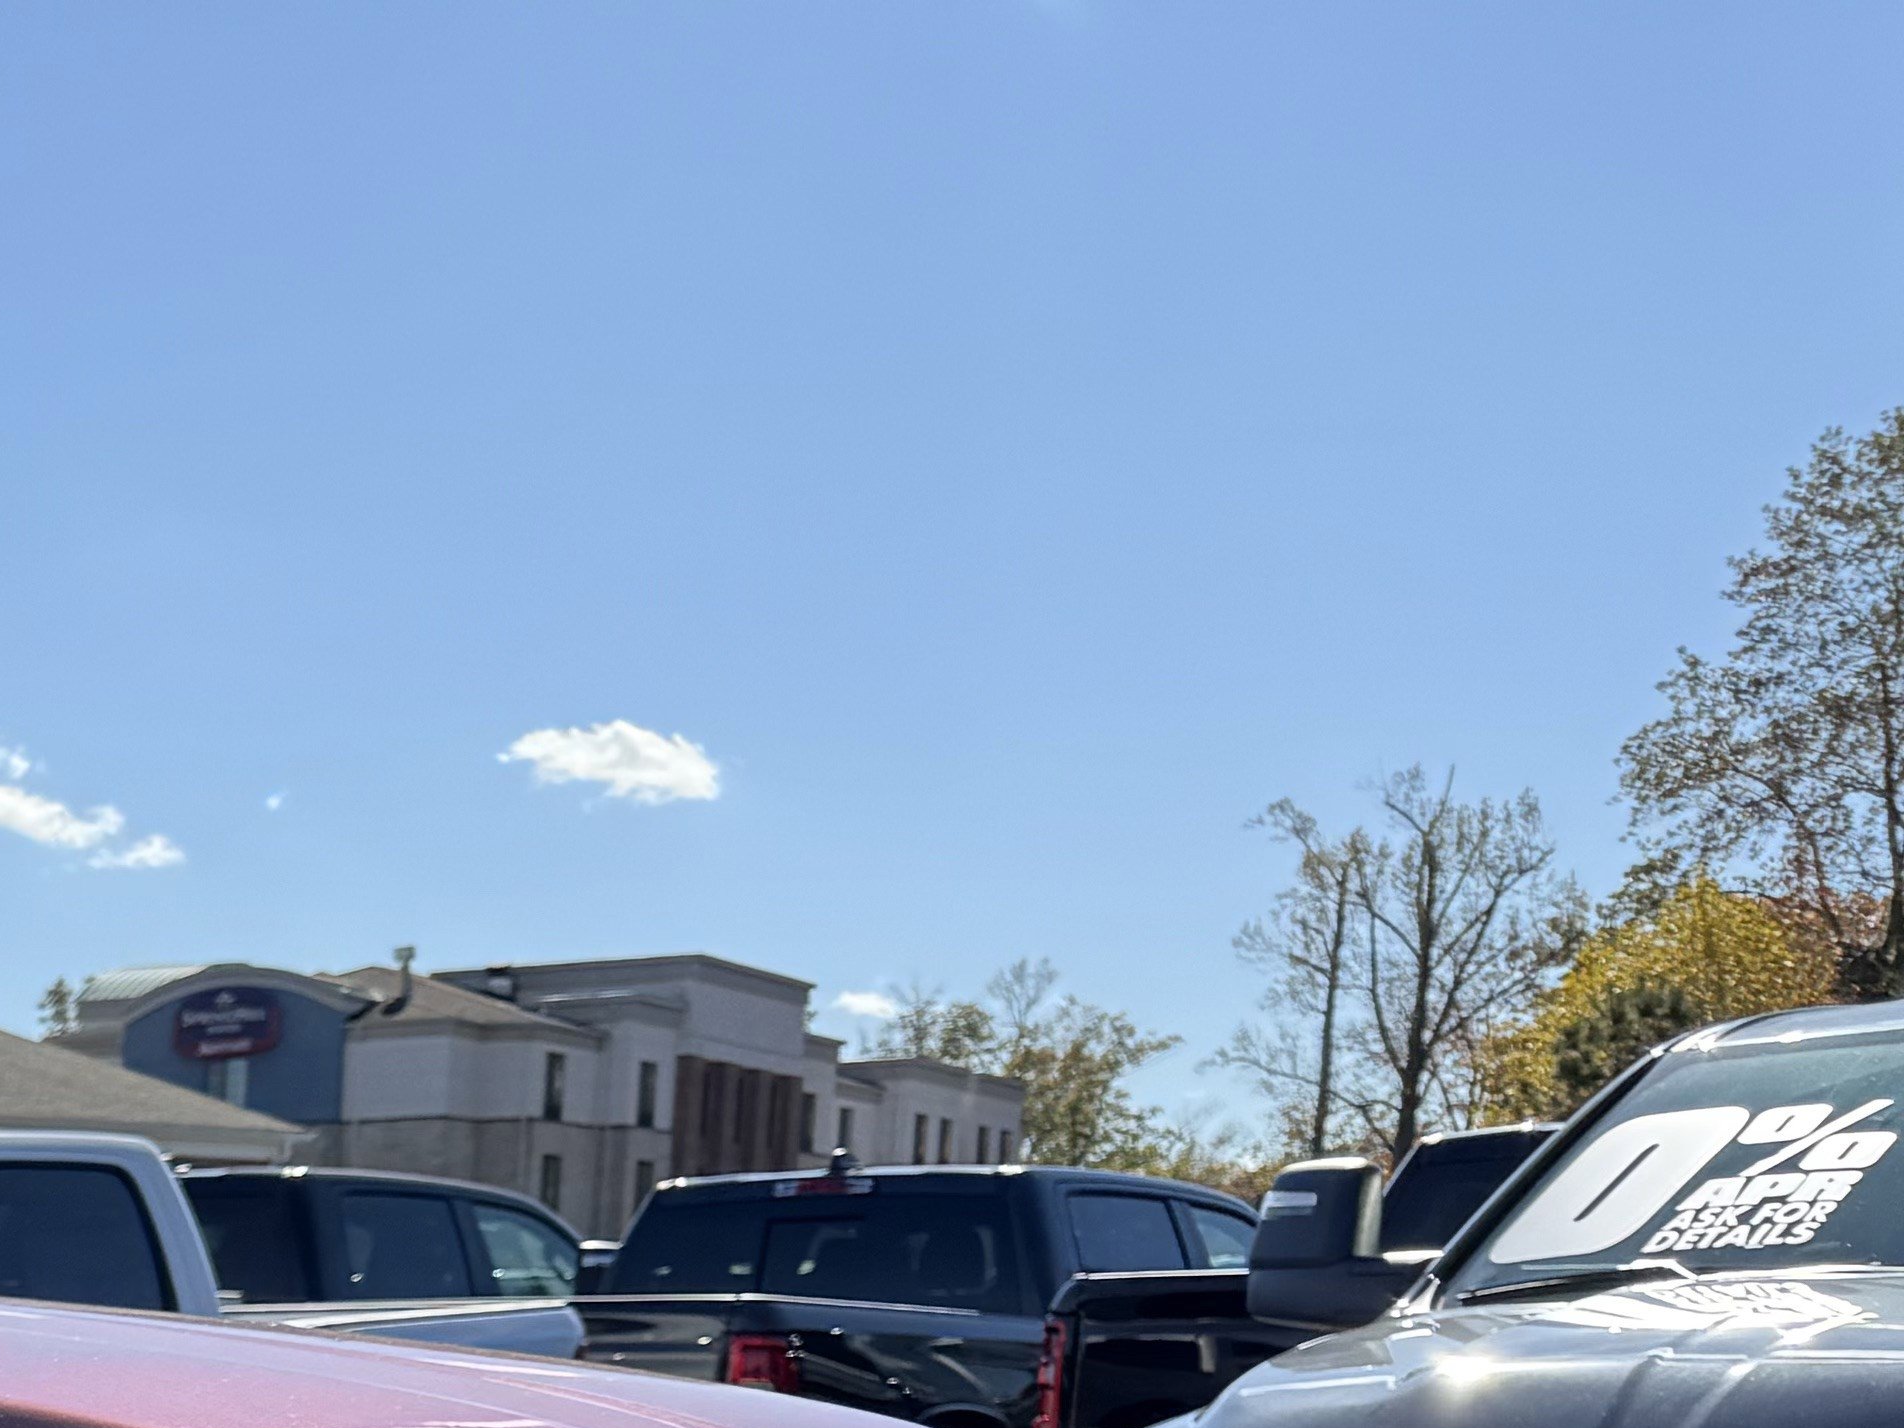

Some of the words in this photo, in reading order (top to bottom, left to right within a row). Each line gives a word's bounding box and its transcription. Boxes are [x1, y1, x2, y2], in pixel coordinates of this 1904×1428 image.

[1490, 1098, 1897, 1264] 0%
[1675, 1170, 1864, 1211] APR
[1660, 1204, 1753, 1231] ASK
[1749, 1201, 1838, 1226] FOR
[1639, 1222, 1822, 1253] DETAILS
